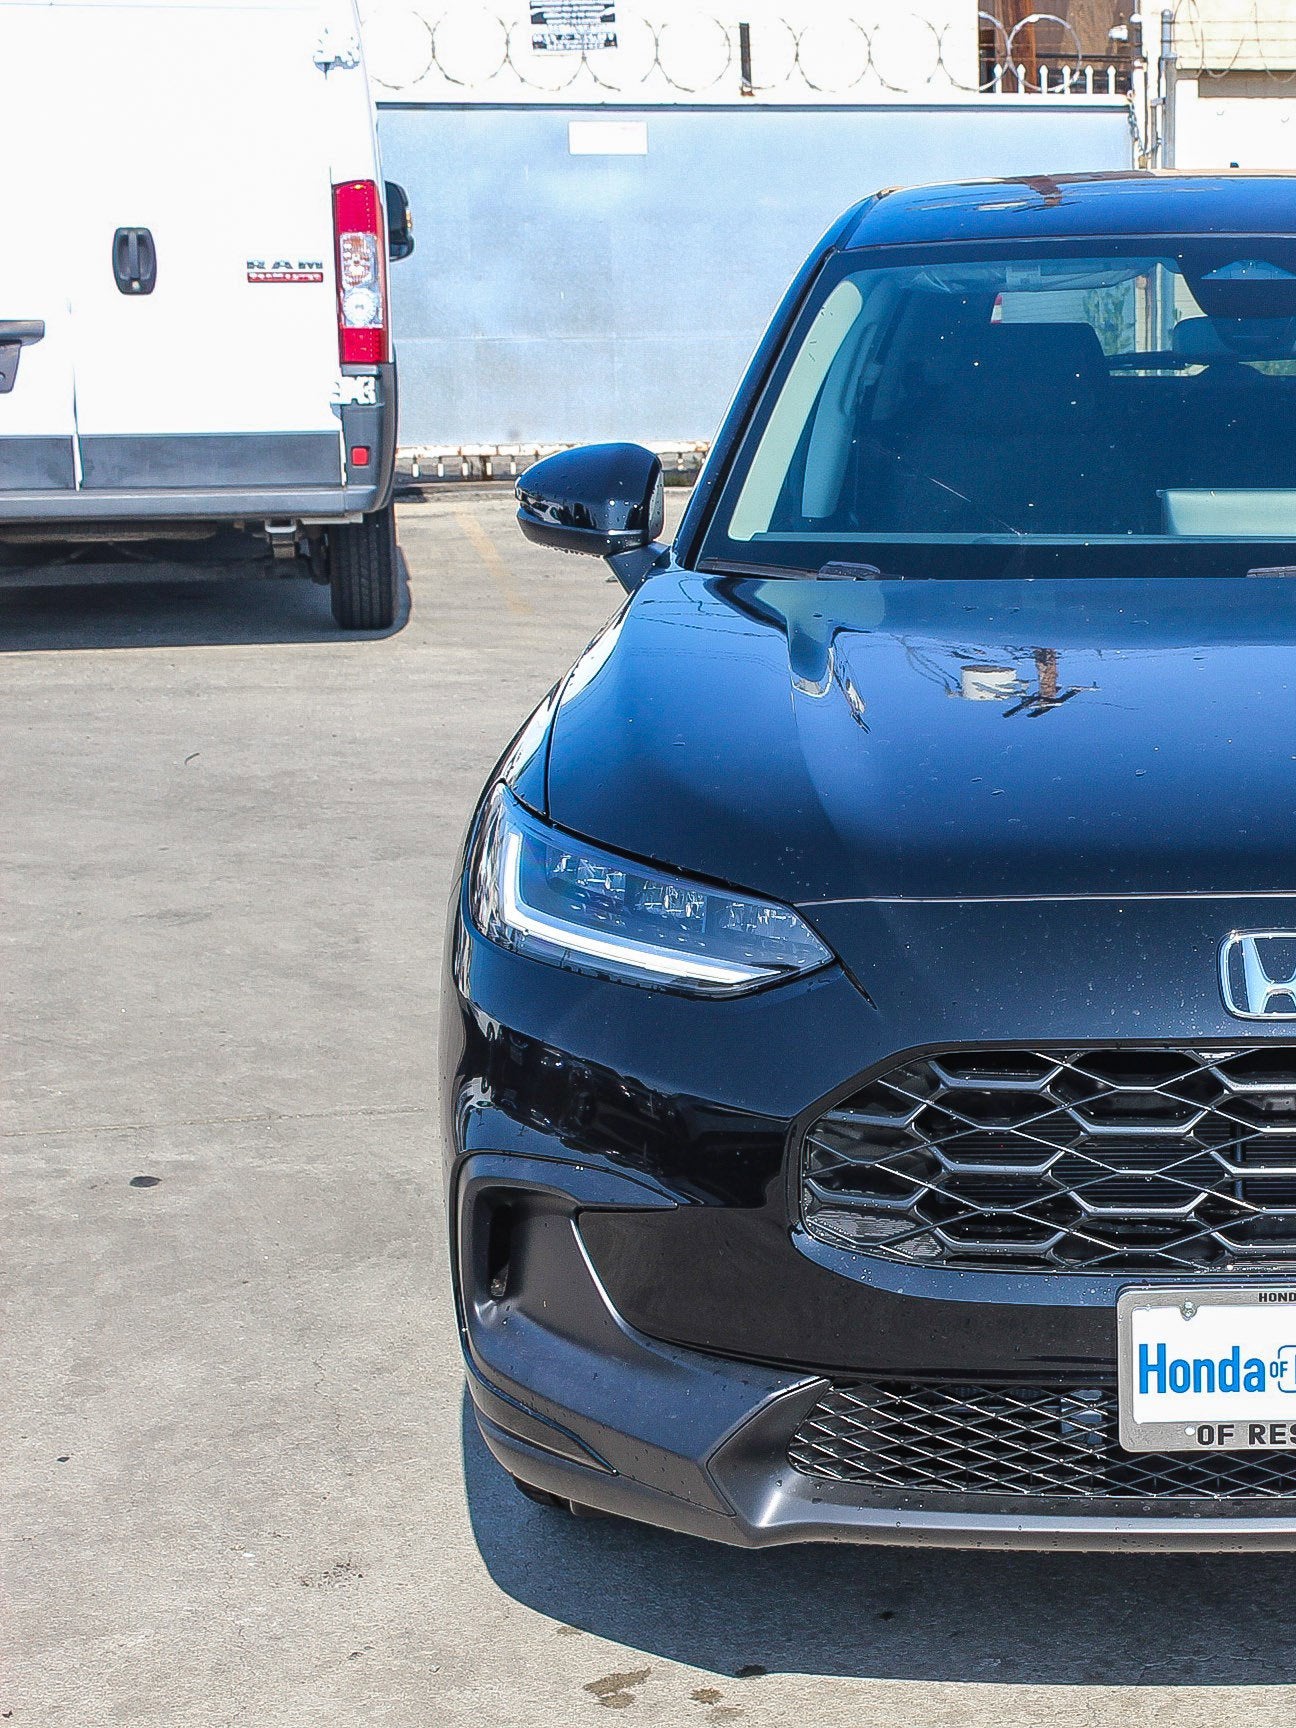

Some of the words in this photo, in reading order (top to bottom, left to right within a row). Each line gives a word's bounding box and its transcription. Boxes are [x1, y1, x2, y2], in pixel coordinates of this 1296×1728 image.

[1138, 1342, 1266, 1395] Honda
[1269, 1360, 1289, 1379] OF
[1197, 1424, 1235, 1446] OF
